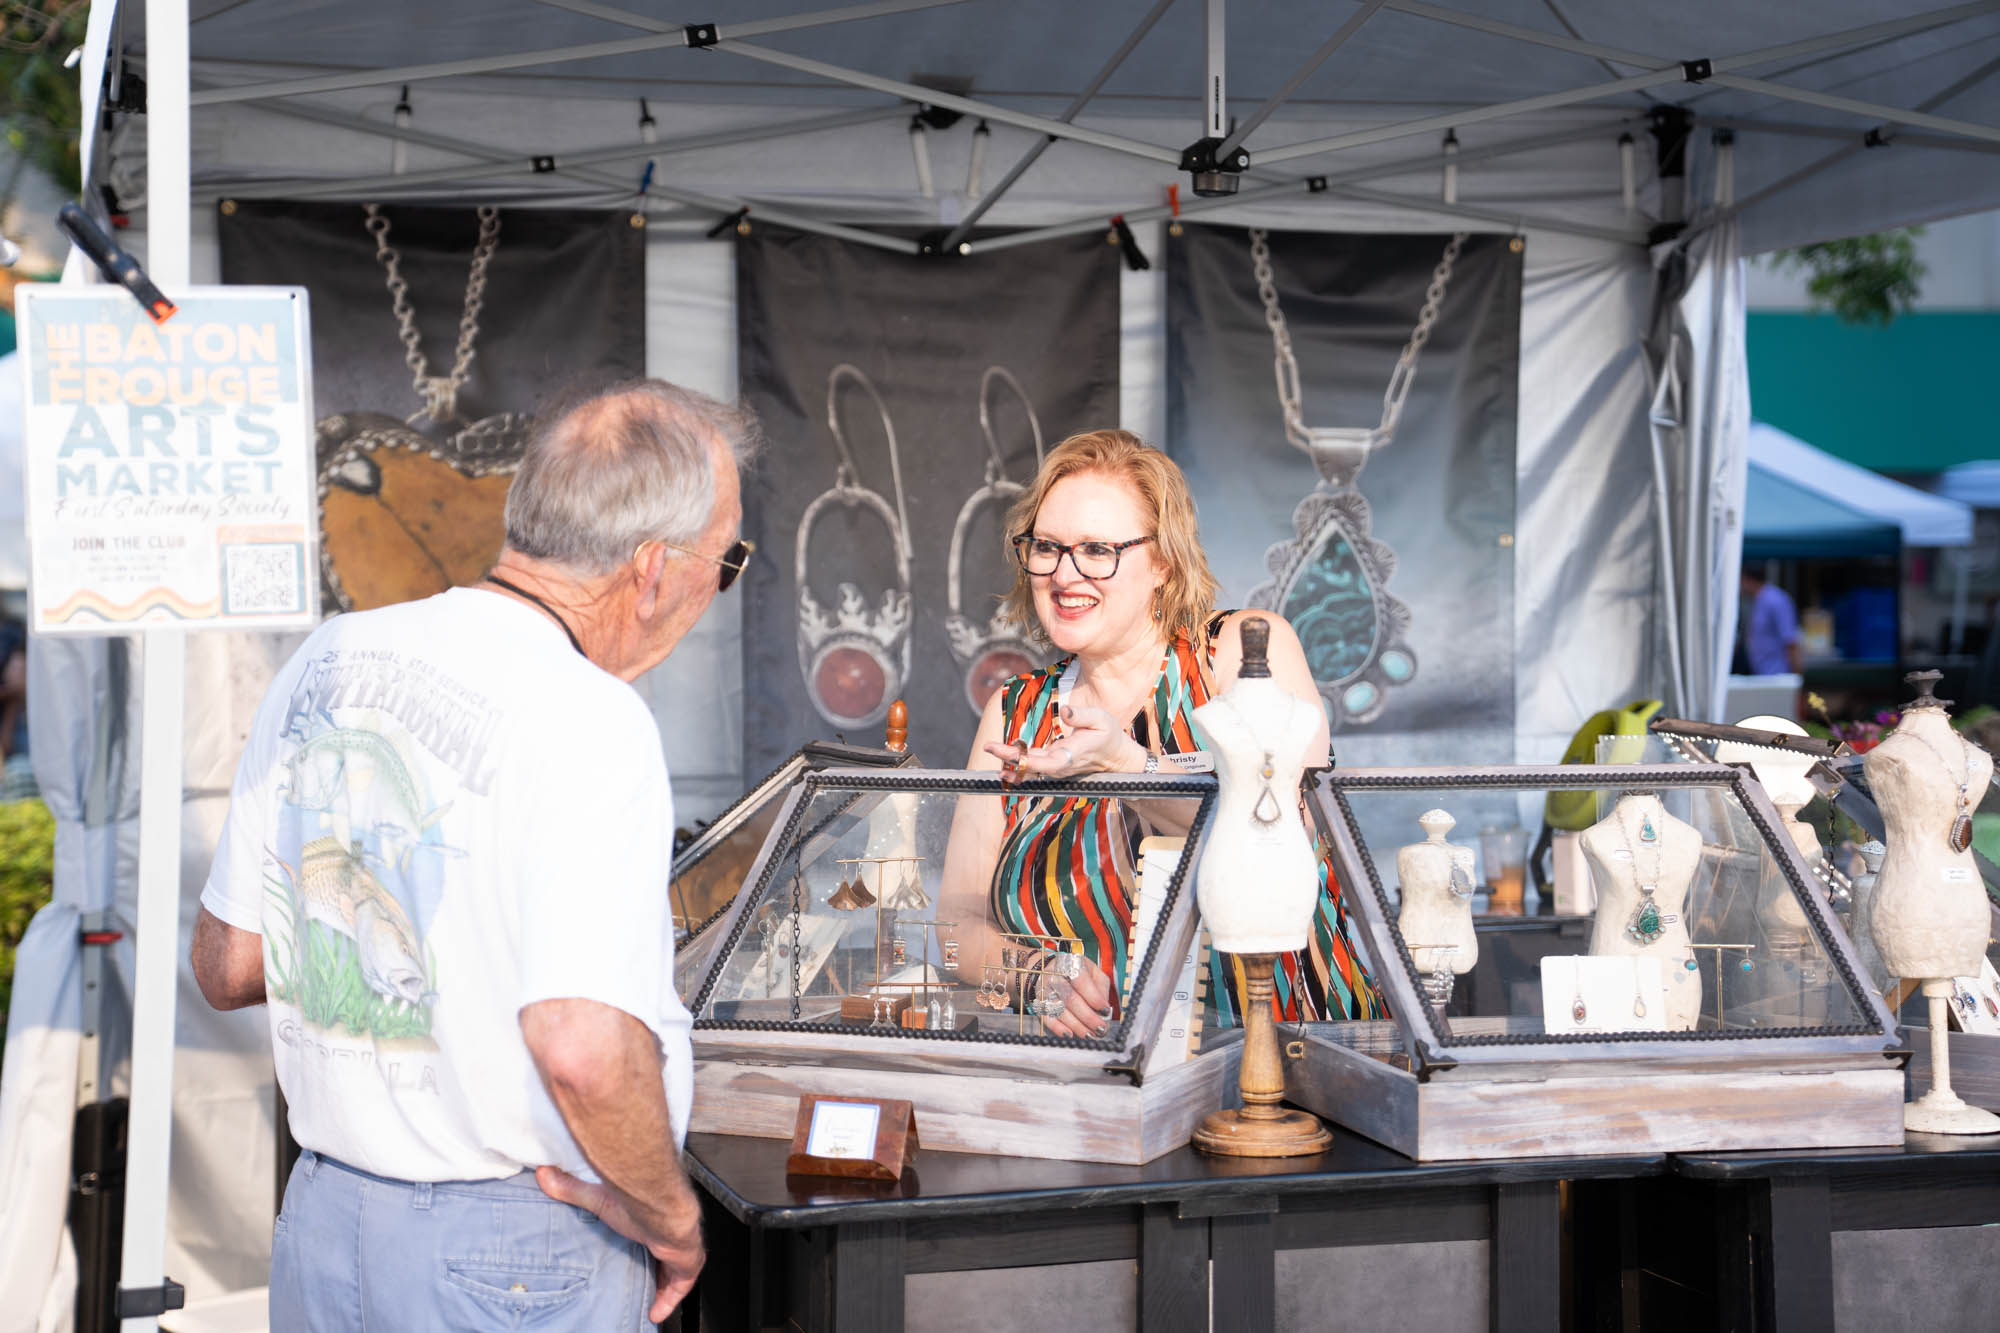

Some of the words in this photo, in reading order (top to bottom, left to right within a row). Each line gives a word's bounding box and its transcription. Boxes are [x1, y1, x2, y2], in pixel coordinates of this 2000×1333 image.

[85, 323, 276, 362] BATON
[47, 324, 83, 405] THE
[84, 365, 281, 405] ROUGE
[56, 403, 282, 458] ARTS
[56, 460, 283, 497] MARKET
[113, 496, 211, 520] Saturday
[217, 494, 289, 520] Society
[71, 536, 105, 551] JOIN
[112, 536, 142, 550] THE
[148, 535, 186, 549] CLUB
[1169, 755, 1197, 763] hristy
